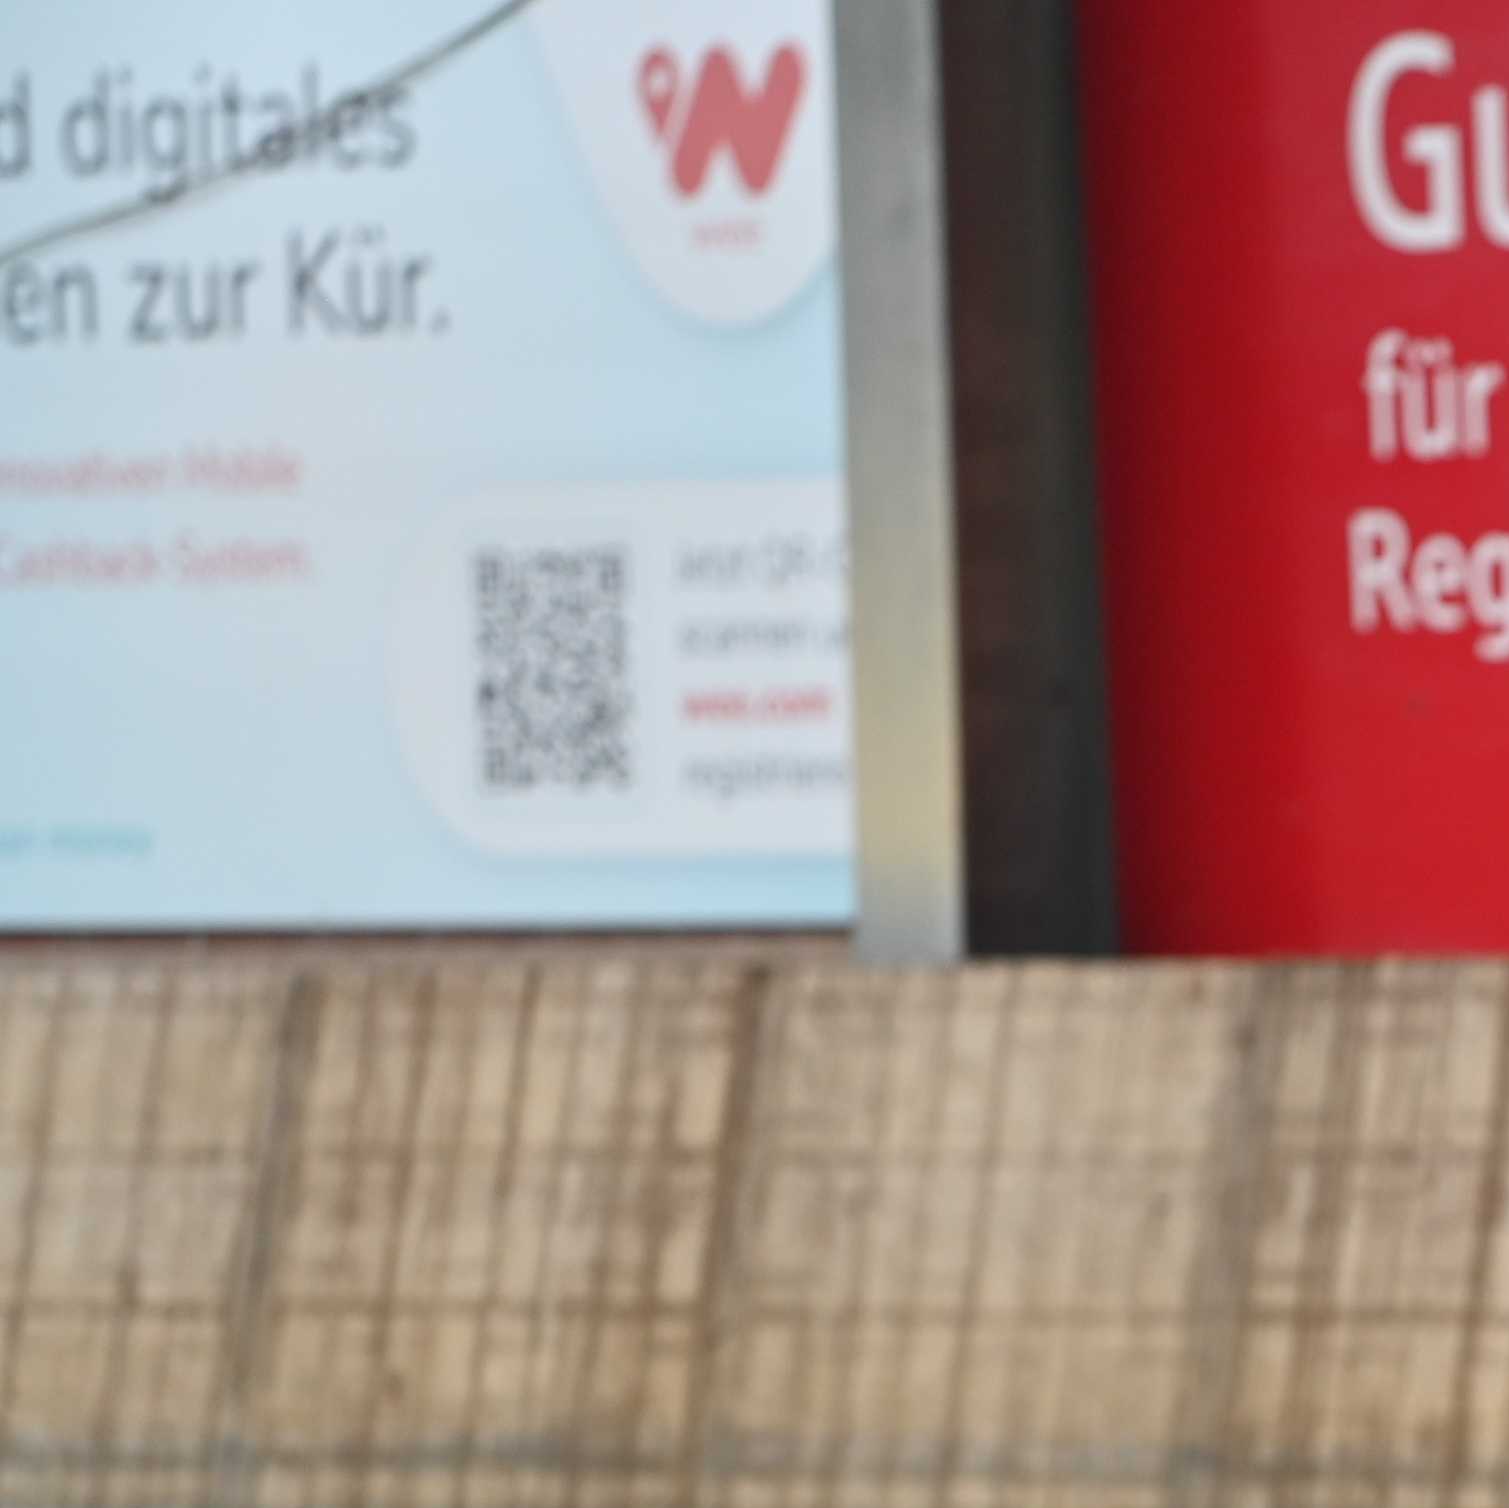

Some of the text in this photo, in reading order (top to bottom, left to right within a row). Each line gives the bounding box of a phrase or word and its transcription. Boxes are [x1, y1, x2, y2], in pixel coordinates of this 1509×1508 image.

[59, 62, 417, 204] digitales
[126, 254, 261, 346] zur
[286, 224, 452, 340] Kür.
[1362, 327, 1504, 461] für
